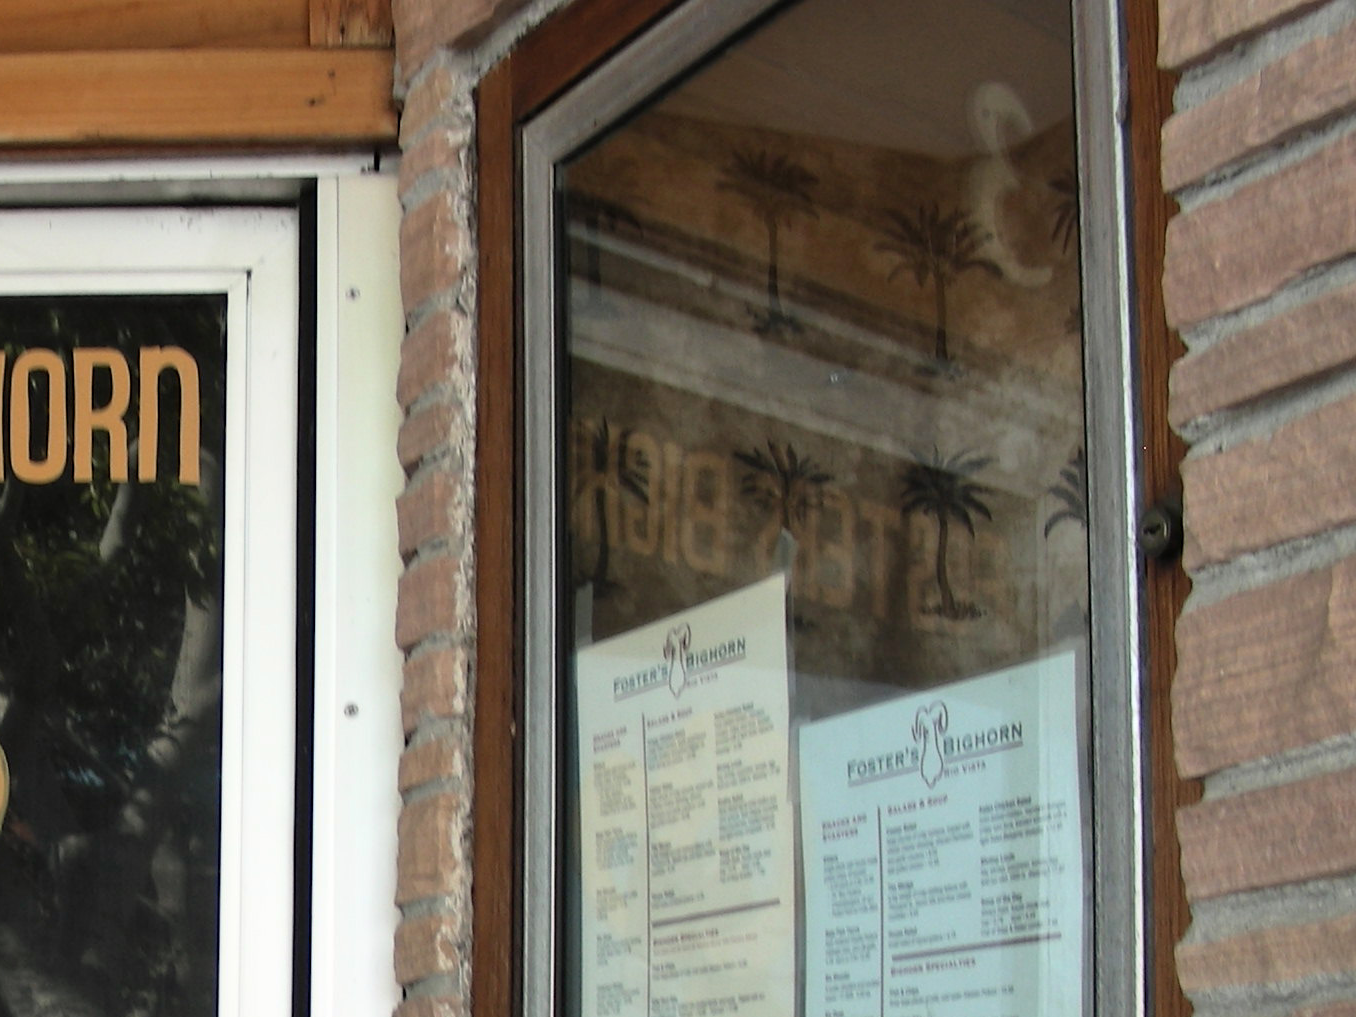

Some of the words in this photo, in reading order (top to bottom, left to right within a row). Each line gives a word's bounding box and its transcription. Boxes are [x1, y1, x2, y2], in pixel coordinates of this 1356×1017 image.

[613, 663, 668, 695] FOSTER'S
[686, 636, 746, 669] BIGHORN
[847, 746, 919, 780] FOSTER'S
[944, 721, 1023, 756] BIGHORN
